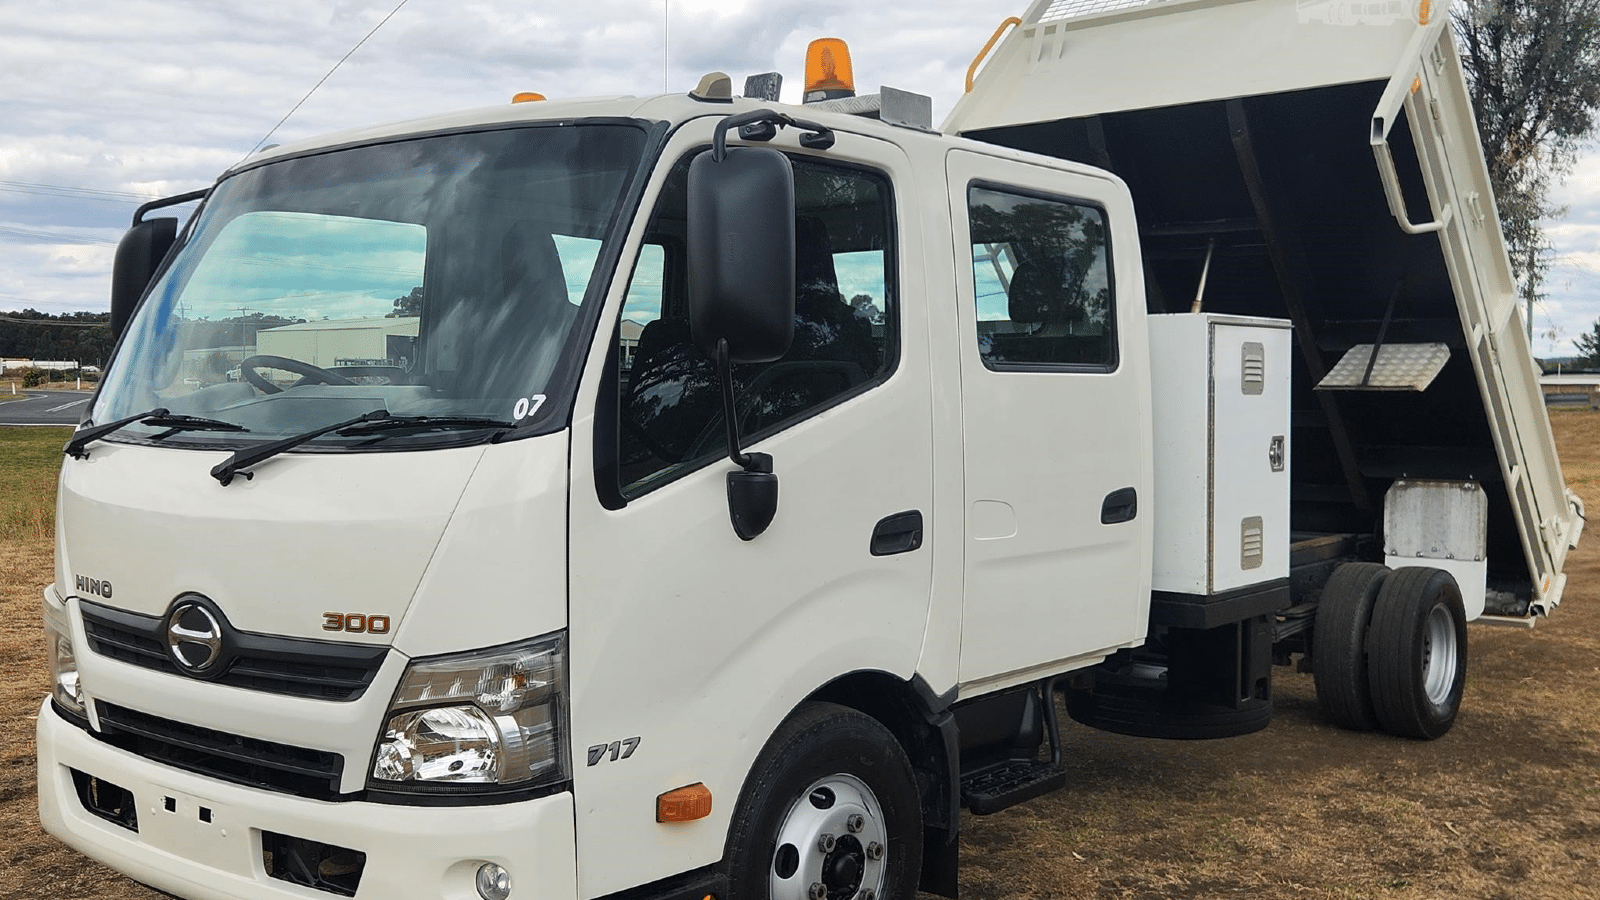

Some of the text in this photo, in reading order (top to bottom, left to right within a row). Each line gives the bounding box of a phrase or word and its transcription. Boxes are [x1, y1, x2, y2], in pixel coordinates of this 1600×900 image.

[513, 394, 547, 420] 07
[75, 574, 112, 598] HINO
[322, 612, 390, 634] 300
[587, 736, 641, 766] 717
